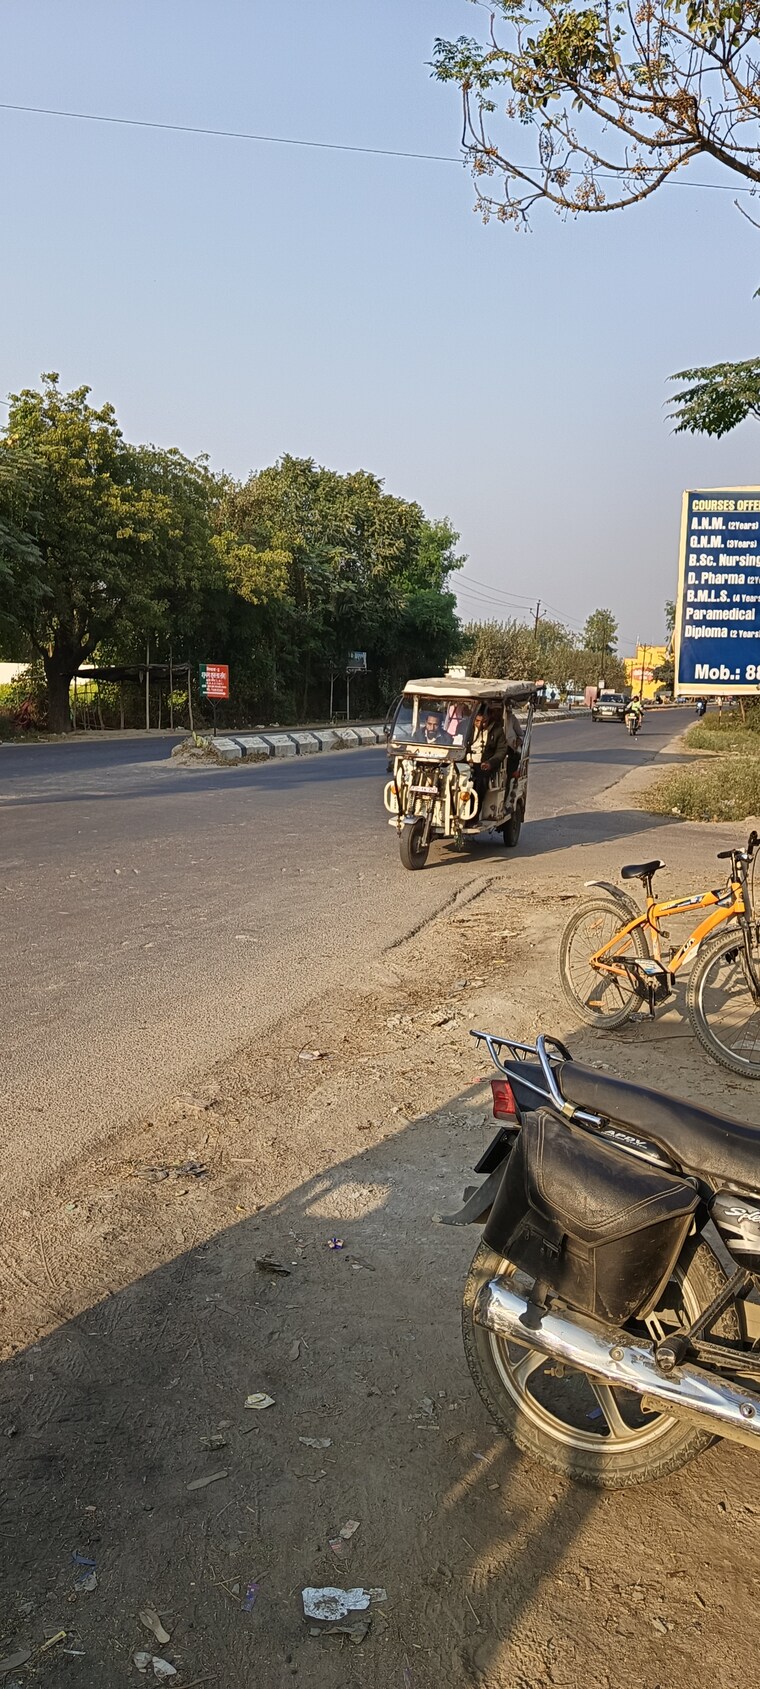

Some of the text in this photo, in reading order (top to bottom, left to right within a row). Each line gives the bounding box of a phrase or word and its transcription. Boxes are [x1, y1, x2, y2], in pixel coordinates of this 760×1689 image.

[692, 500, 735, 511] COURSES
[691, 517, 759, 530] A.N.M. (2Years)
[690, 536, 757, 548] G.N.M. (3Years)
[689, 554, 760, 567] B.Sc. Nursing
[688, 572, 699, 584] D.
[701, 572, 745, 584] Pharma
[687, 590, 731, 602] B.M.L.S.
[733, 594, 740, 602] (4
[686, 608, 755, 620] Paramedical
[685, 625, 728, 639] Diploma
[730, 630, 738, 638] (2
[695, 664, 740, 680] Mob.:
